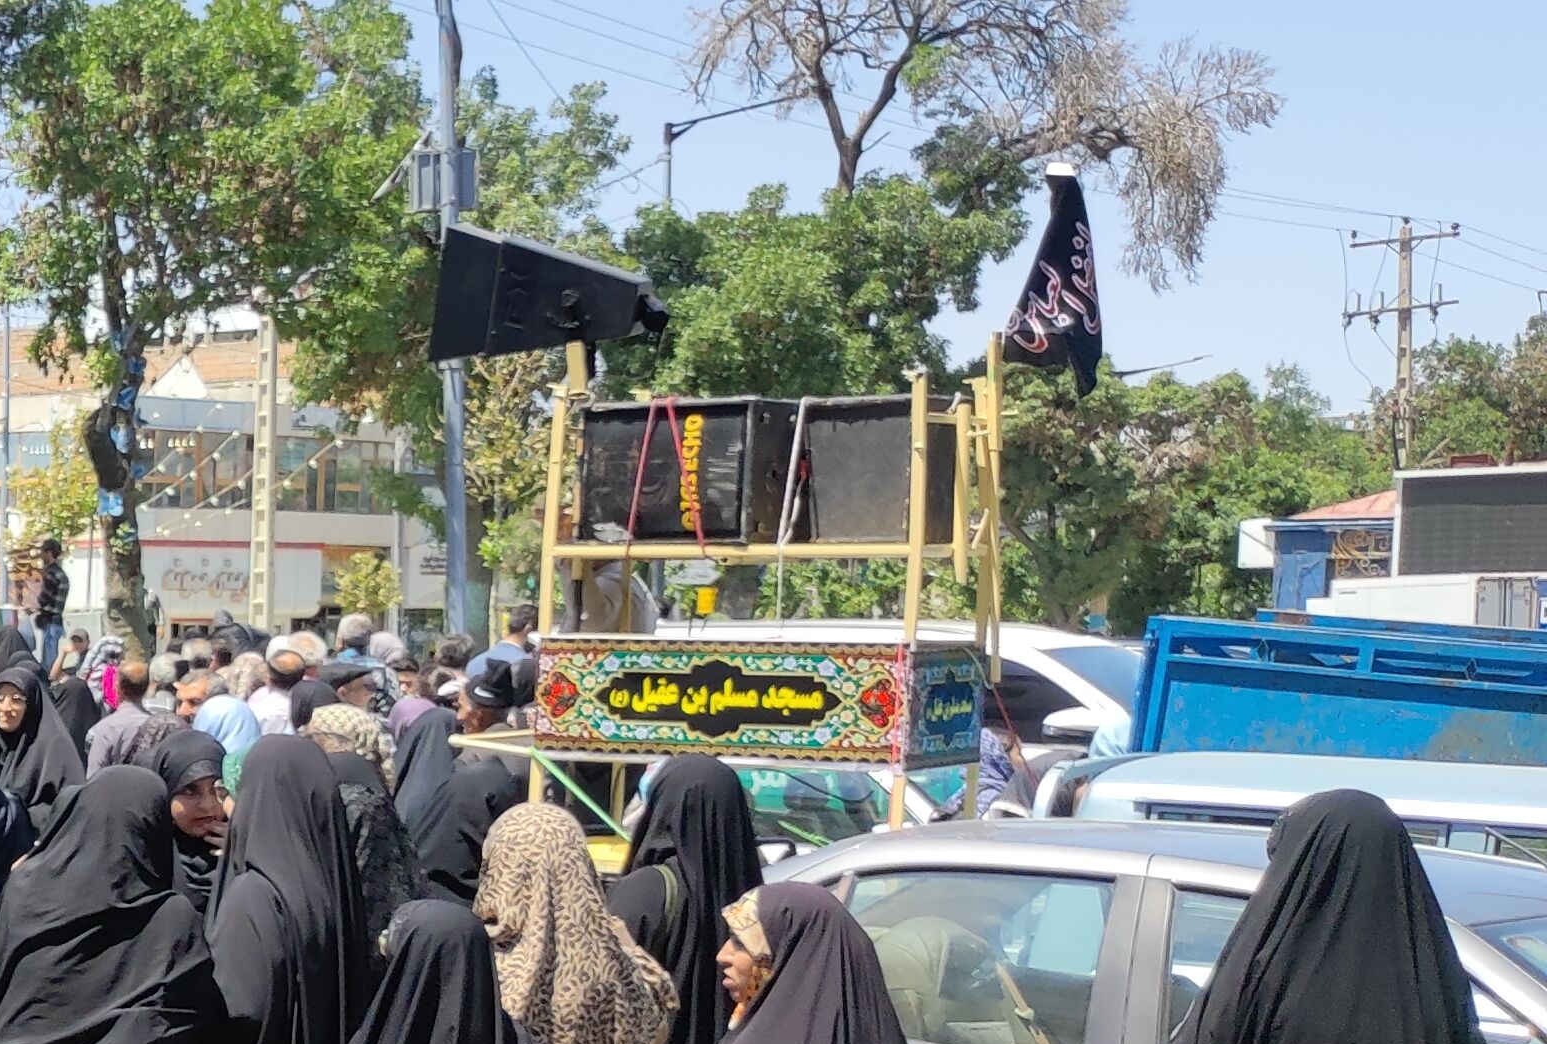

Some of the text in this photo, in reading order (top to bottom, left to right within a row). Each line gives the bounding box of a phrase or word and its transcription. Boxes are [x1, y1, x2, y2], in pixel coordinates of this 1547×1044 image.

[631, 676, 680, 713] عقیل
[680, 686, 709, 715] بن
[709, 677, 758, 716] مسلم
[762, 684, 824, 717] مسجد
